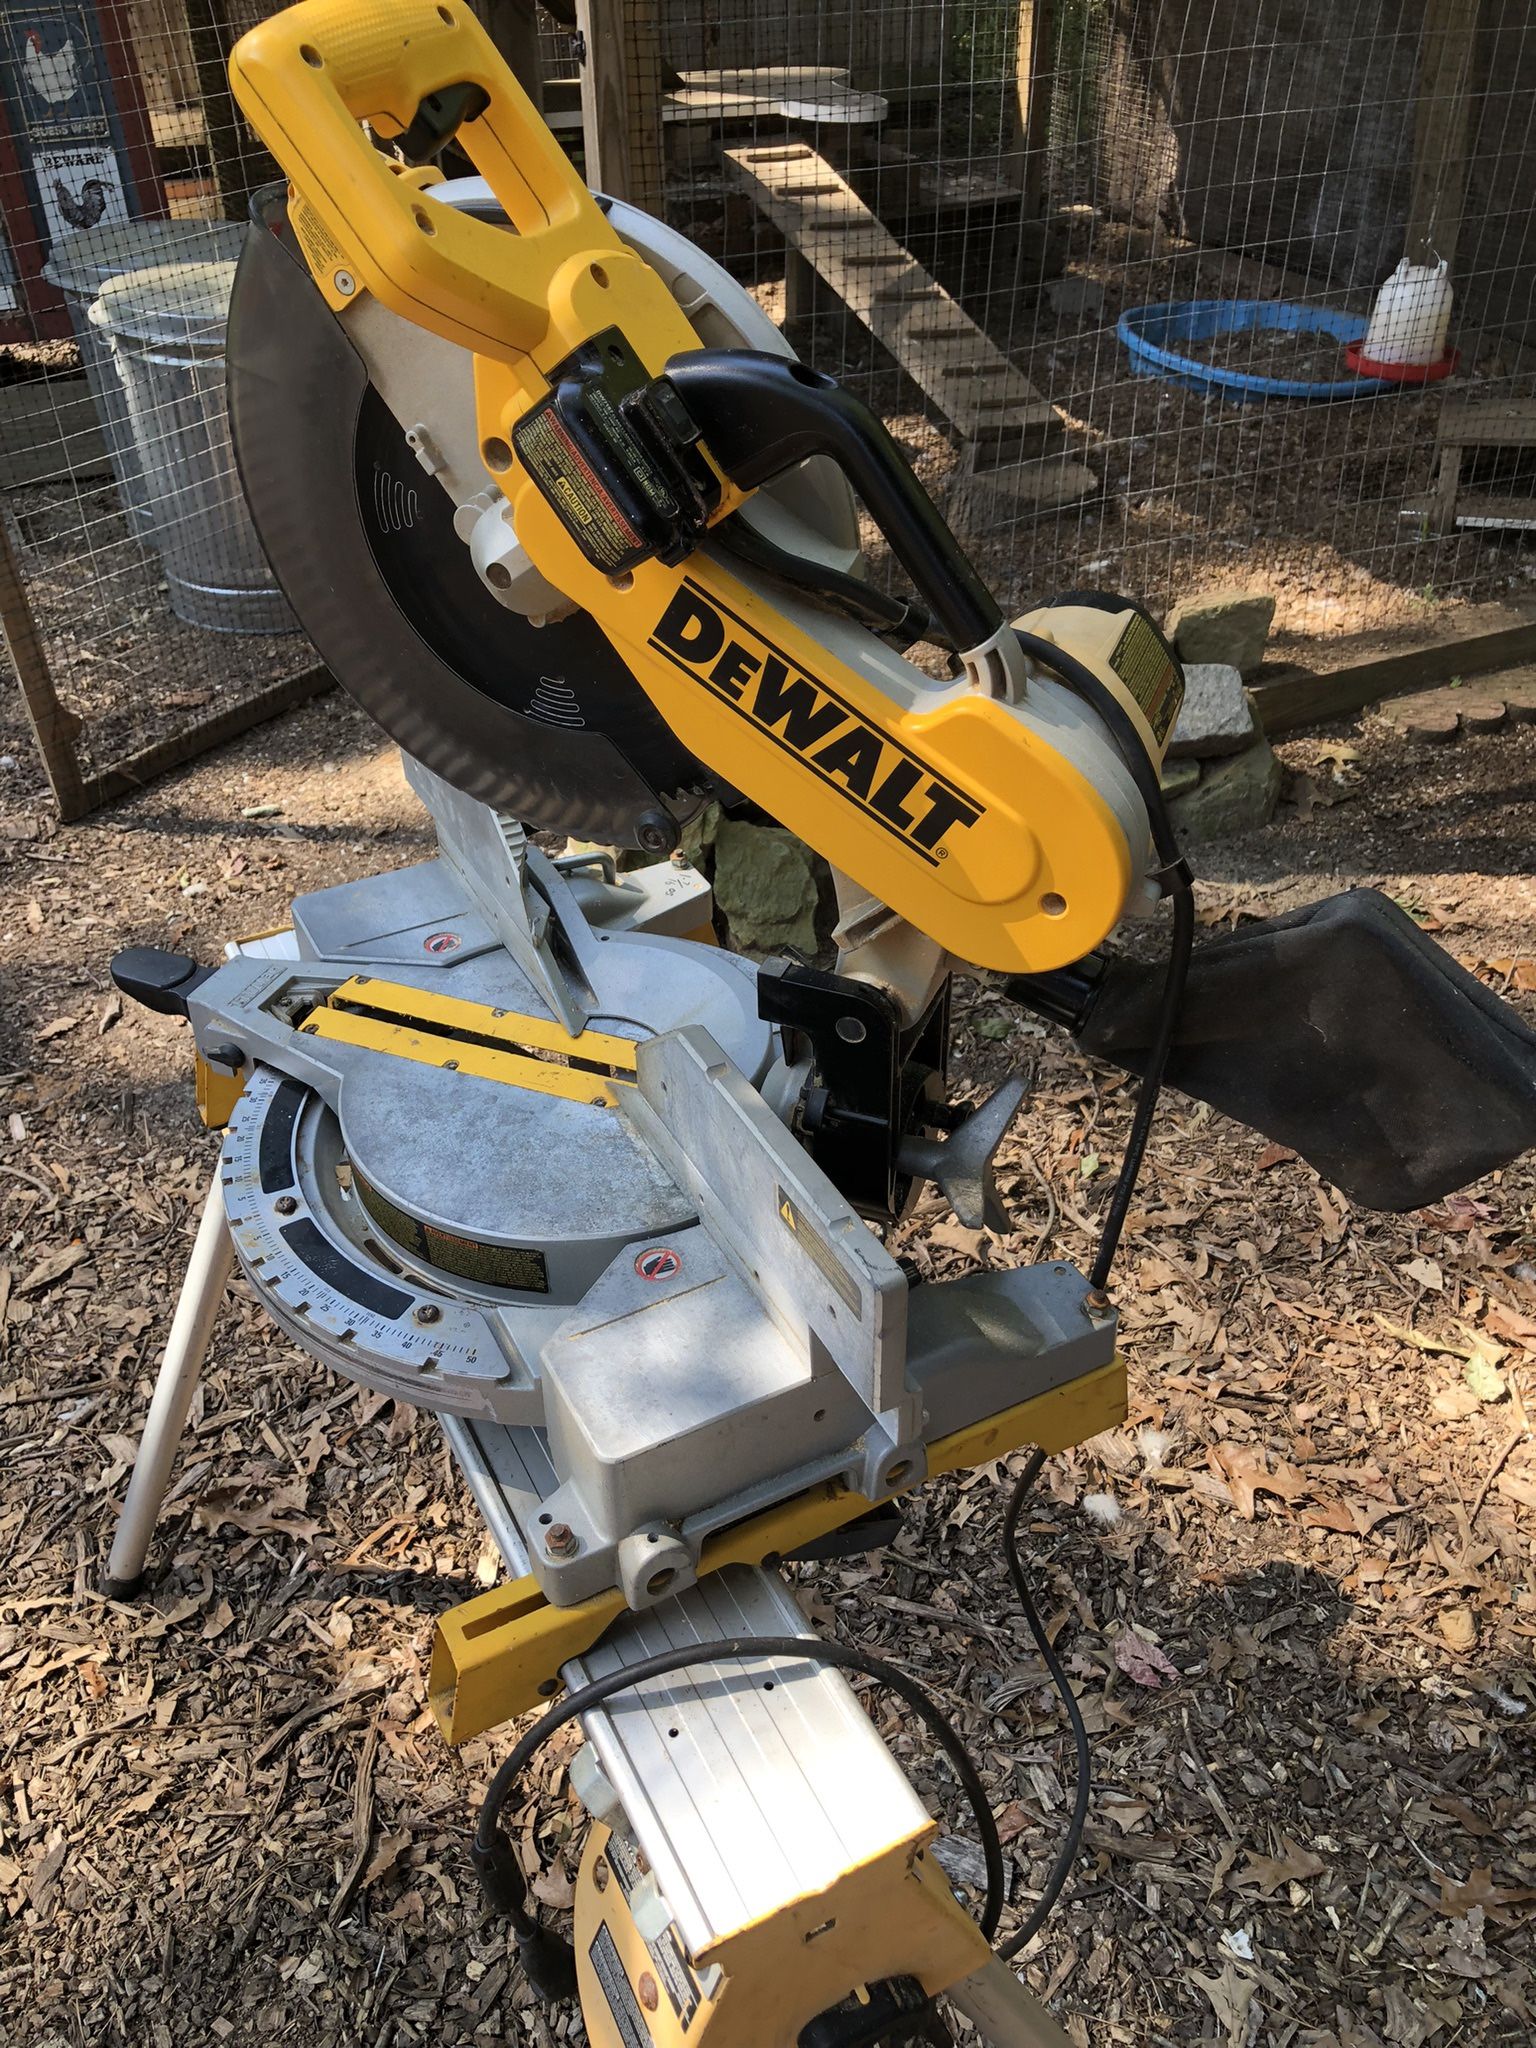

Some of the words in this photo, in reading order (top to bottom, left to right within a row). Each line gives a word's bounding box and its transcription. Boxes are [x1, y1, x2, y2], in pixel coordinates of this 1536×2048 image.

[43, 152, 105, 169] BEWARE
[563, 487, 590, 523] CAUTION
[234, 1155, 243, 1163] 15
[235, 1175, 243, 1183] 10
[265, 1253, 275, 1262] 10
[280, 1270, 290, 1280] 15
[298, 1287, 310, 1297] 20
[319, 1303, 331, 1312] 25
[344, 1317, 356, 1326] 30
[371, 1330, 383, 1340] 35
[401, 1340, 413, 1350] 40
[431, 1349, 444, 1359] 45
[465, 1355, 478, 1365] 50
